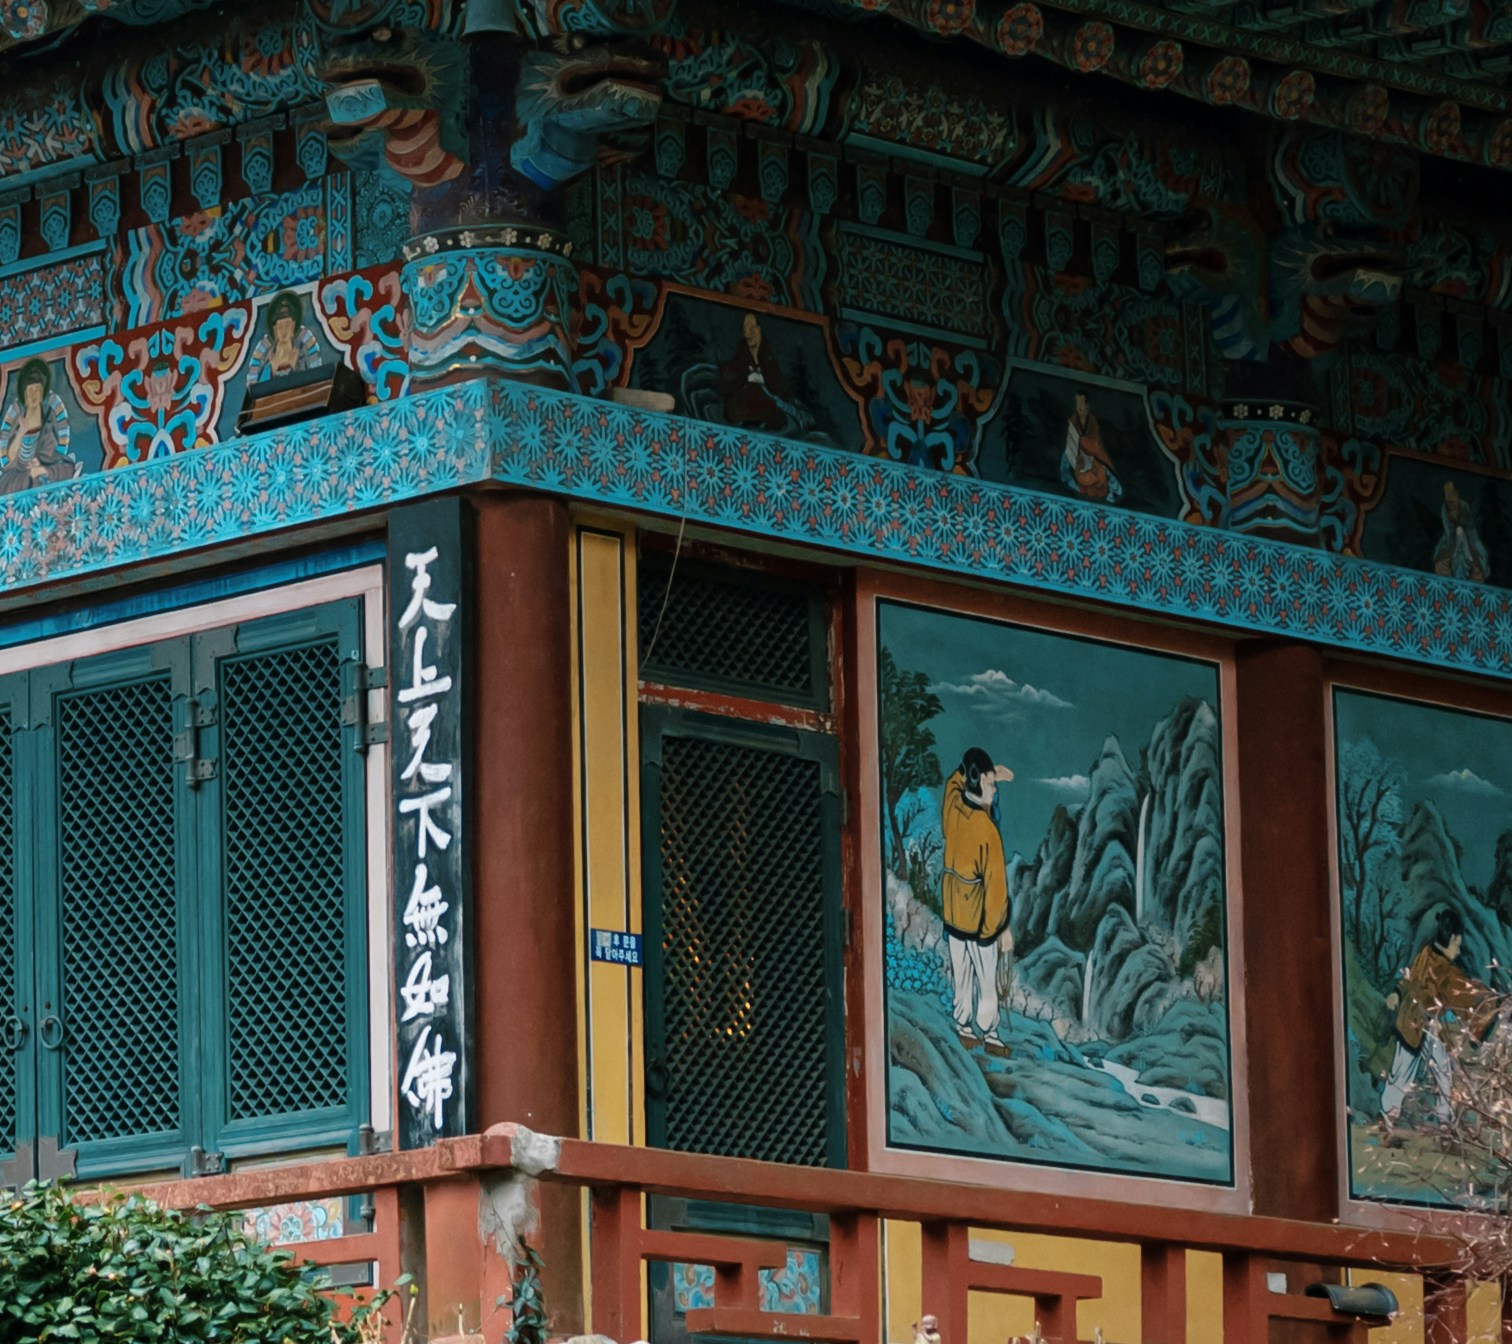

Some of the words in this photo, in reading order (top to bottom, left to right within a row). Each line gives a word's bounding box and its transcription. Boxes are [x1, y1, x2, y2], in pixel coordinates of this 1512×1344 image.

[397, 545, 457, 1130] 天上天下無如佛
